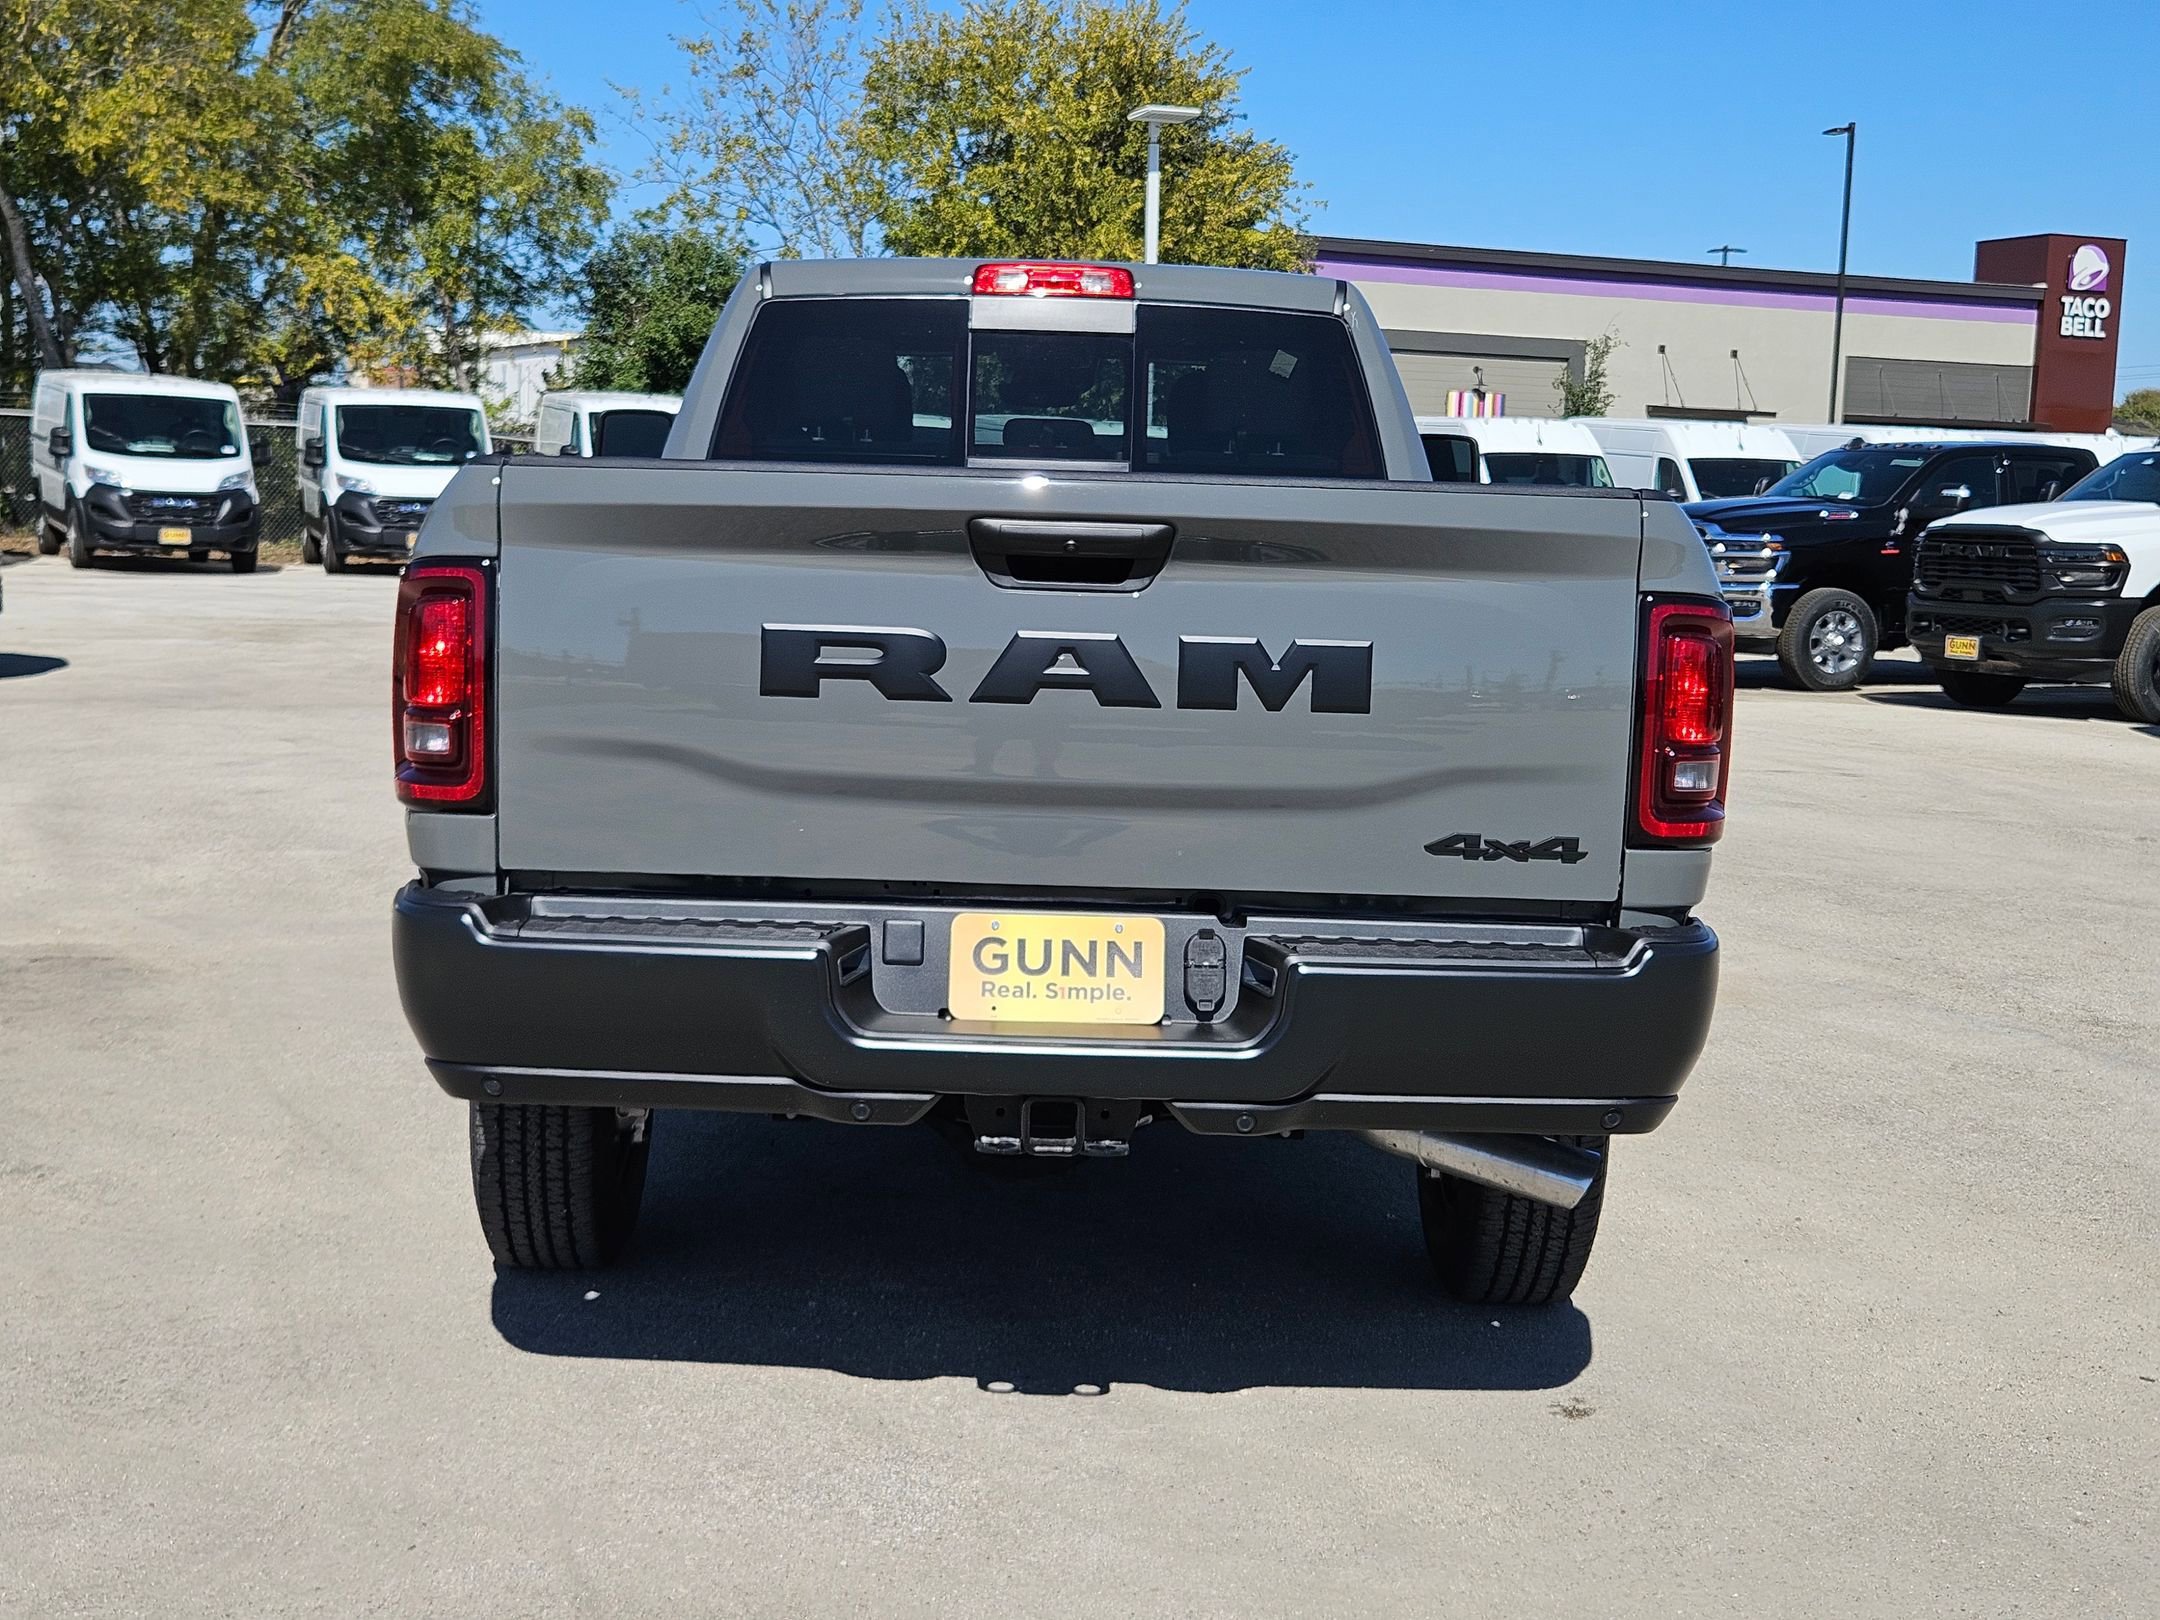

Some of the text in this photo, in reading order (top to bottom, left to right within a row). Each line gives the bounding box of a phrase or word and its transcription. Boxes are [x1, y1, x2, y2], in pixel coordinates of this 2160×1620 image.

[2061, 295, 2111, 319] TACO
[2060, 316, 2106, 338] BELL
[1950, 640, 1976, 650] GUNN
[760, 623, 1374, 715] RAM
[1424, 832, 1589, 865] 4x4
[972, 936, 1143, 978] GUNN
[981, 981, 1037, 999] Real.
